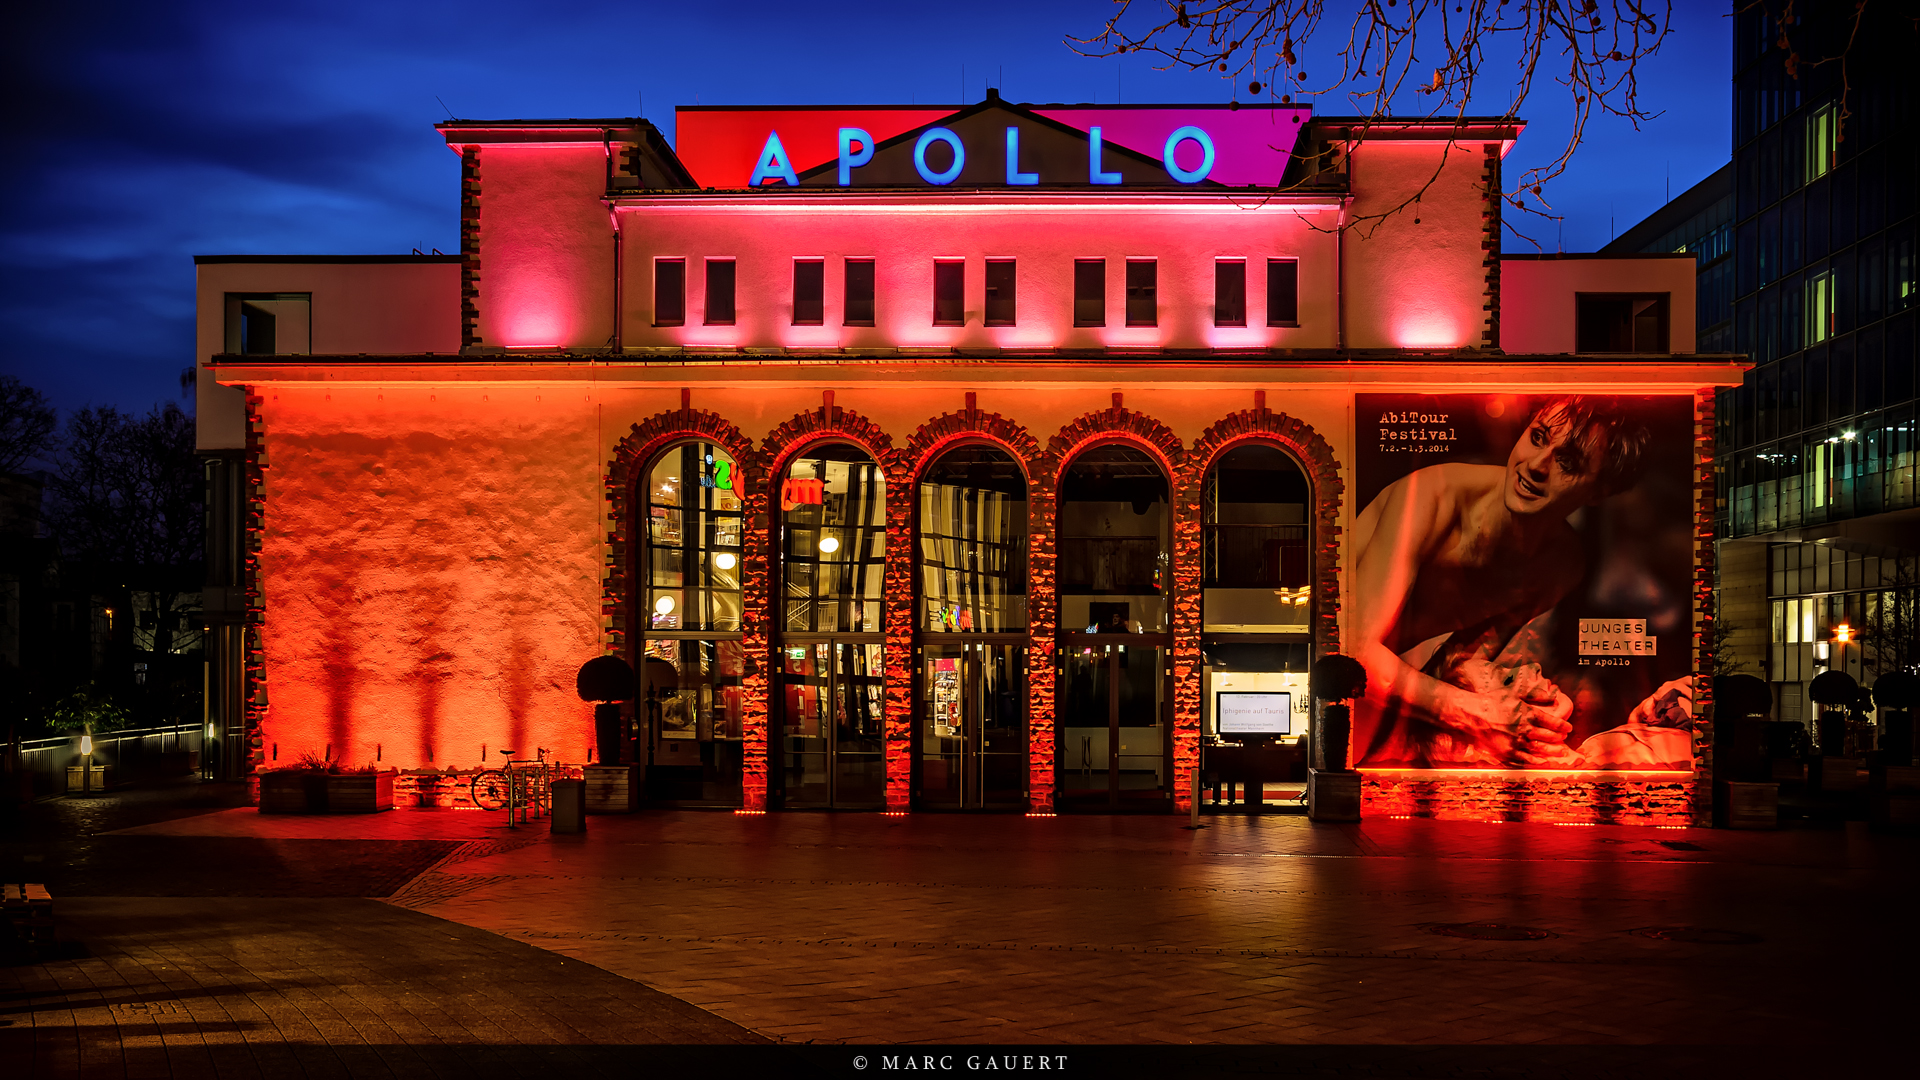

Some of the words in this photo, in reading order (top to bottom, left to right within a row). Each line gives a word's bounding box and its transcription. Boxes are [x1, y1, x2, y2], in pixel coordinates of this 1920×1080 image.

[748, 126, 1215, 185] APOLLO
[1379, 411, 1449, 424] AbiTour
[1379, 428, 1457, 441] Festival
[1580, 623, 1643, 634] JUNGES
[1580, 640, 1653, 651] THEATER
[1578, 657, 1590, 666] im
[1595, 657, 1631, 668] Apollo
[1222, 707, 1251, 716] Iphigenie
